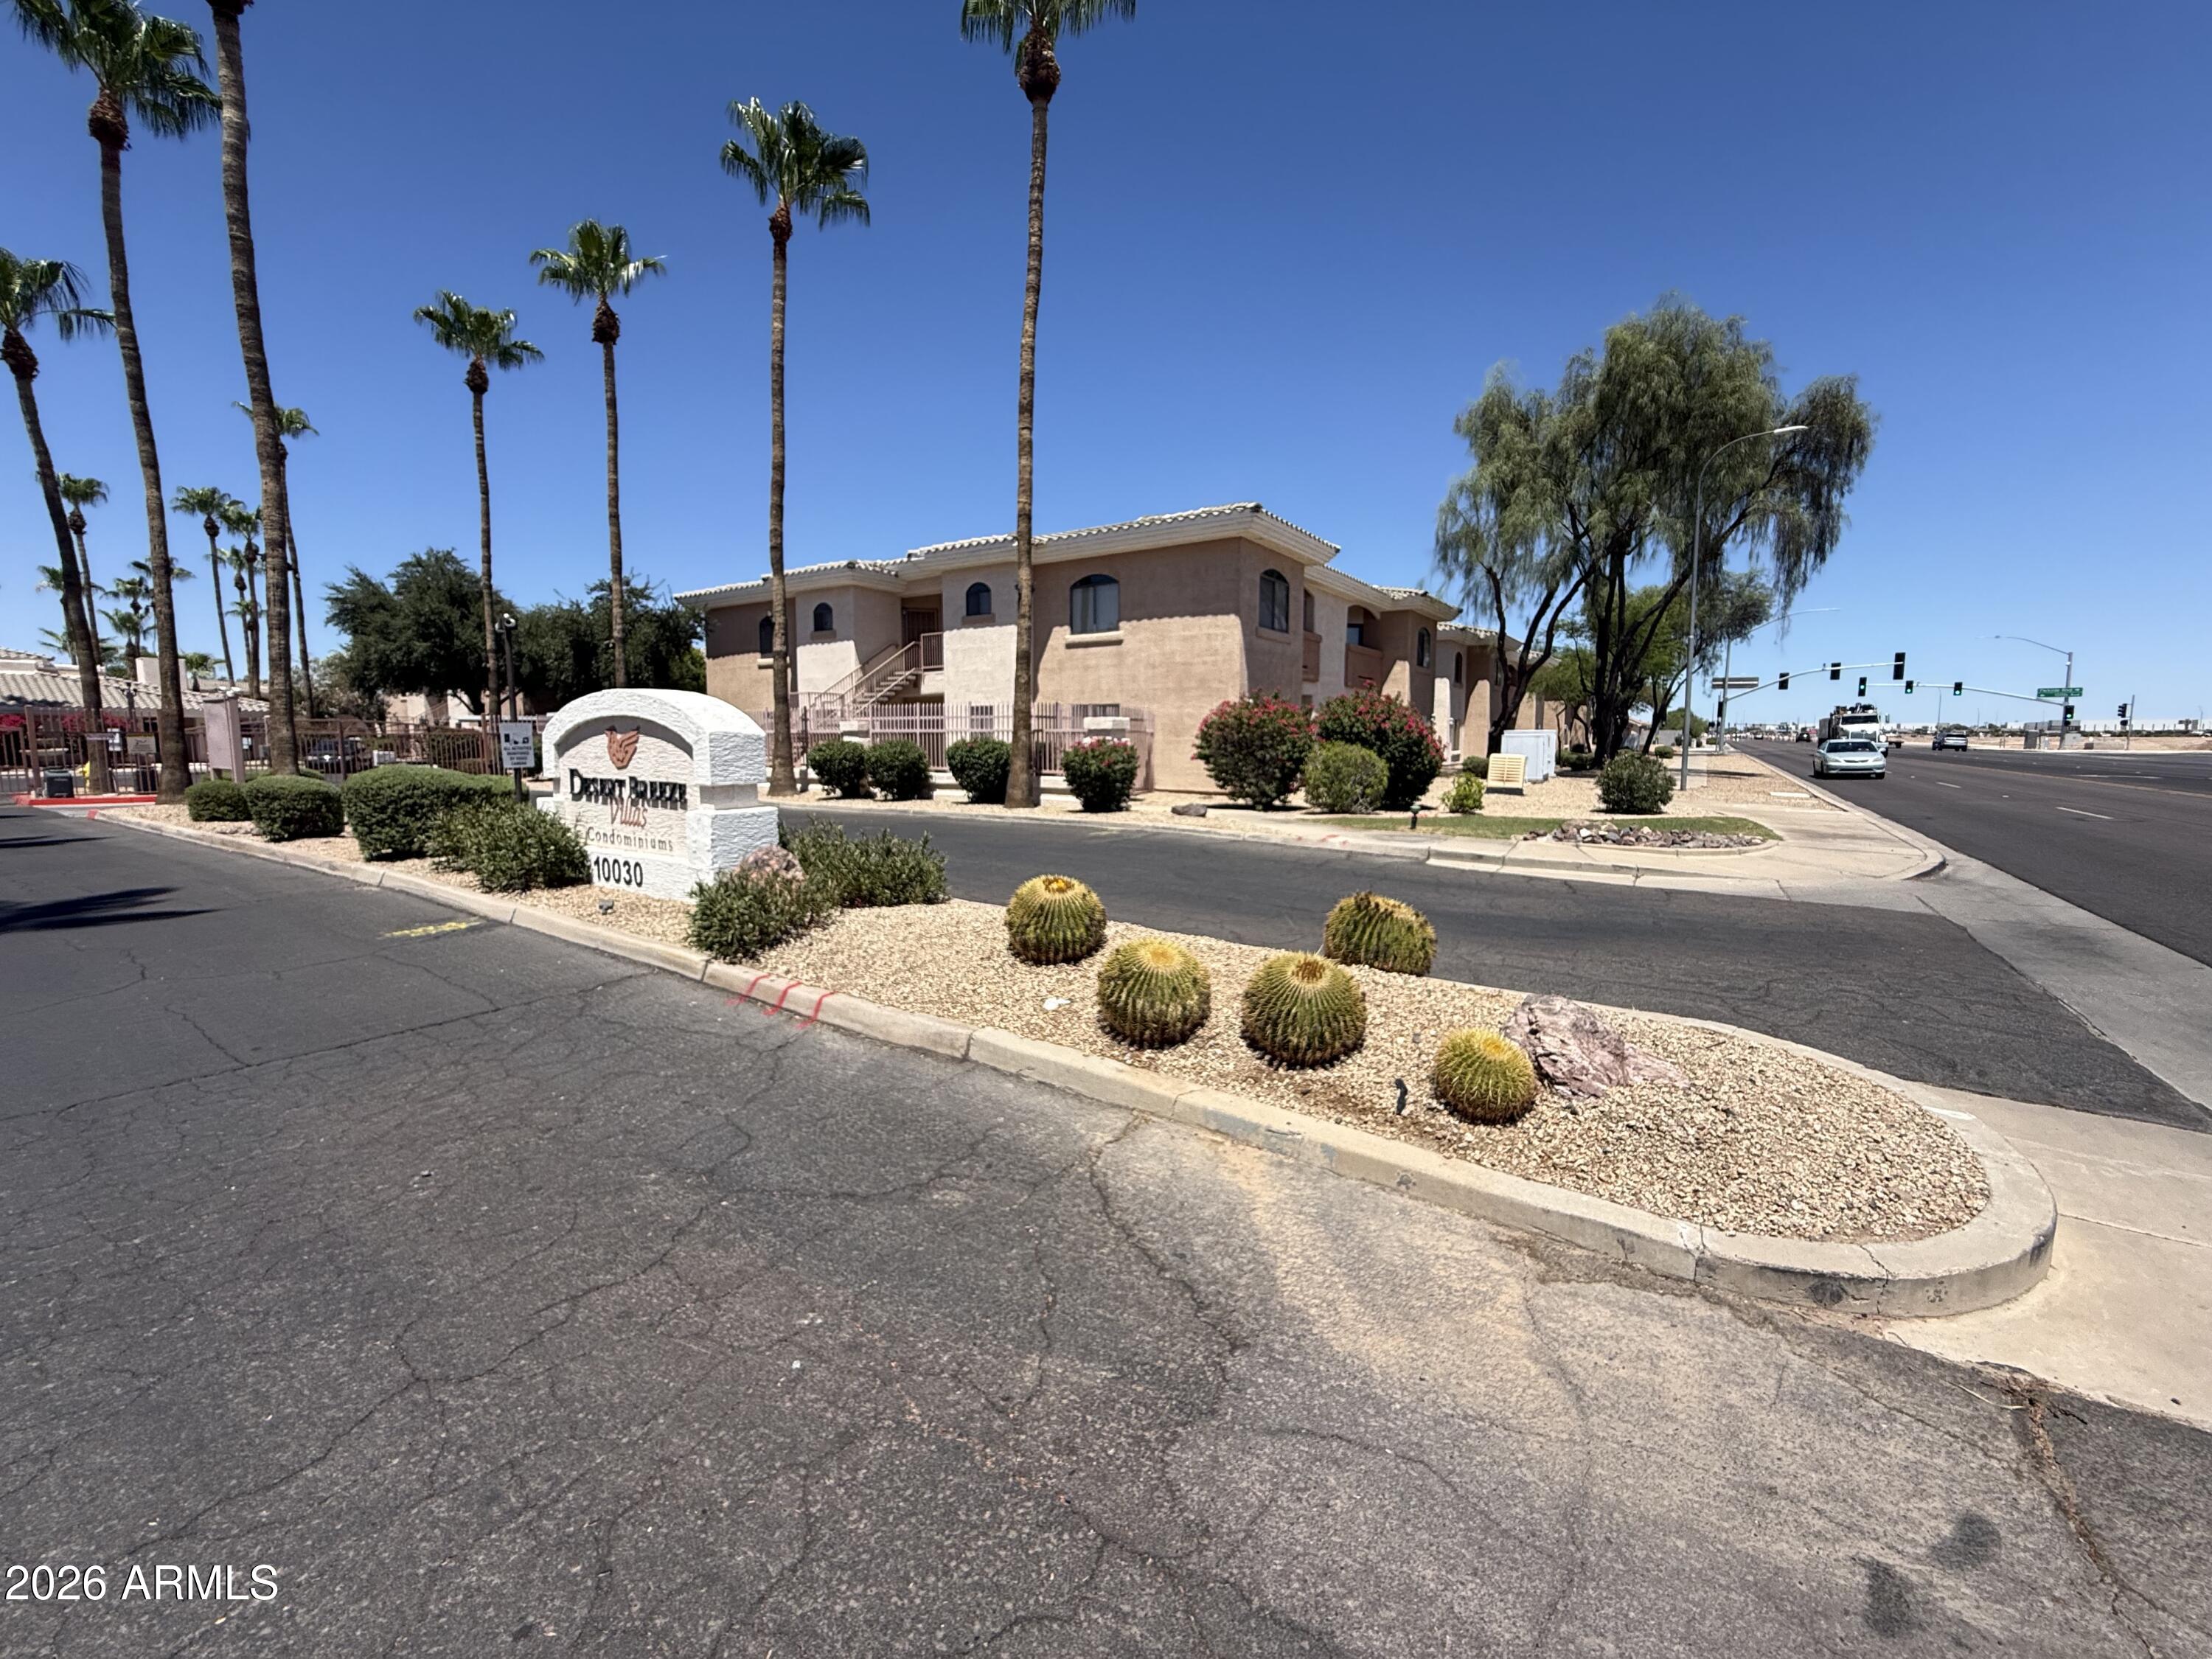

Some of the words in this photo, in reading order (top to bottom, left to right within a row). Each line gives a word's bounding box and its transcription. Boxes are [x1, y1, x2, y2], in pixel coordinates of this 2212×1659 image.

[568, 768, 626, 799] DESERT
[628, 776, 687, 804] BREEZE
[608, 793, 648, 830] Villas
[587, 826, 673, 852] Condominiums
[594, 855, 644, 888] 10030
